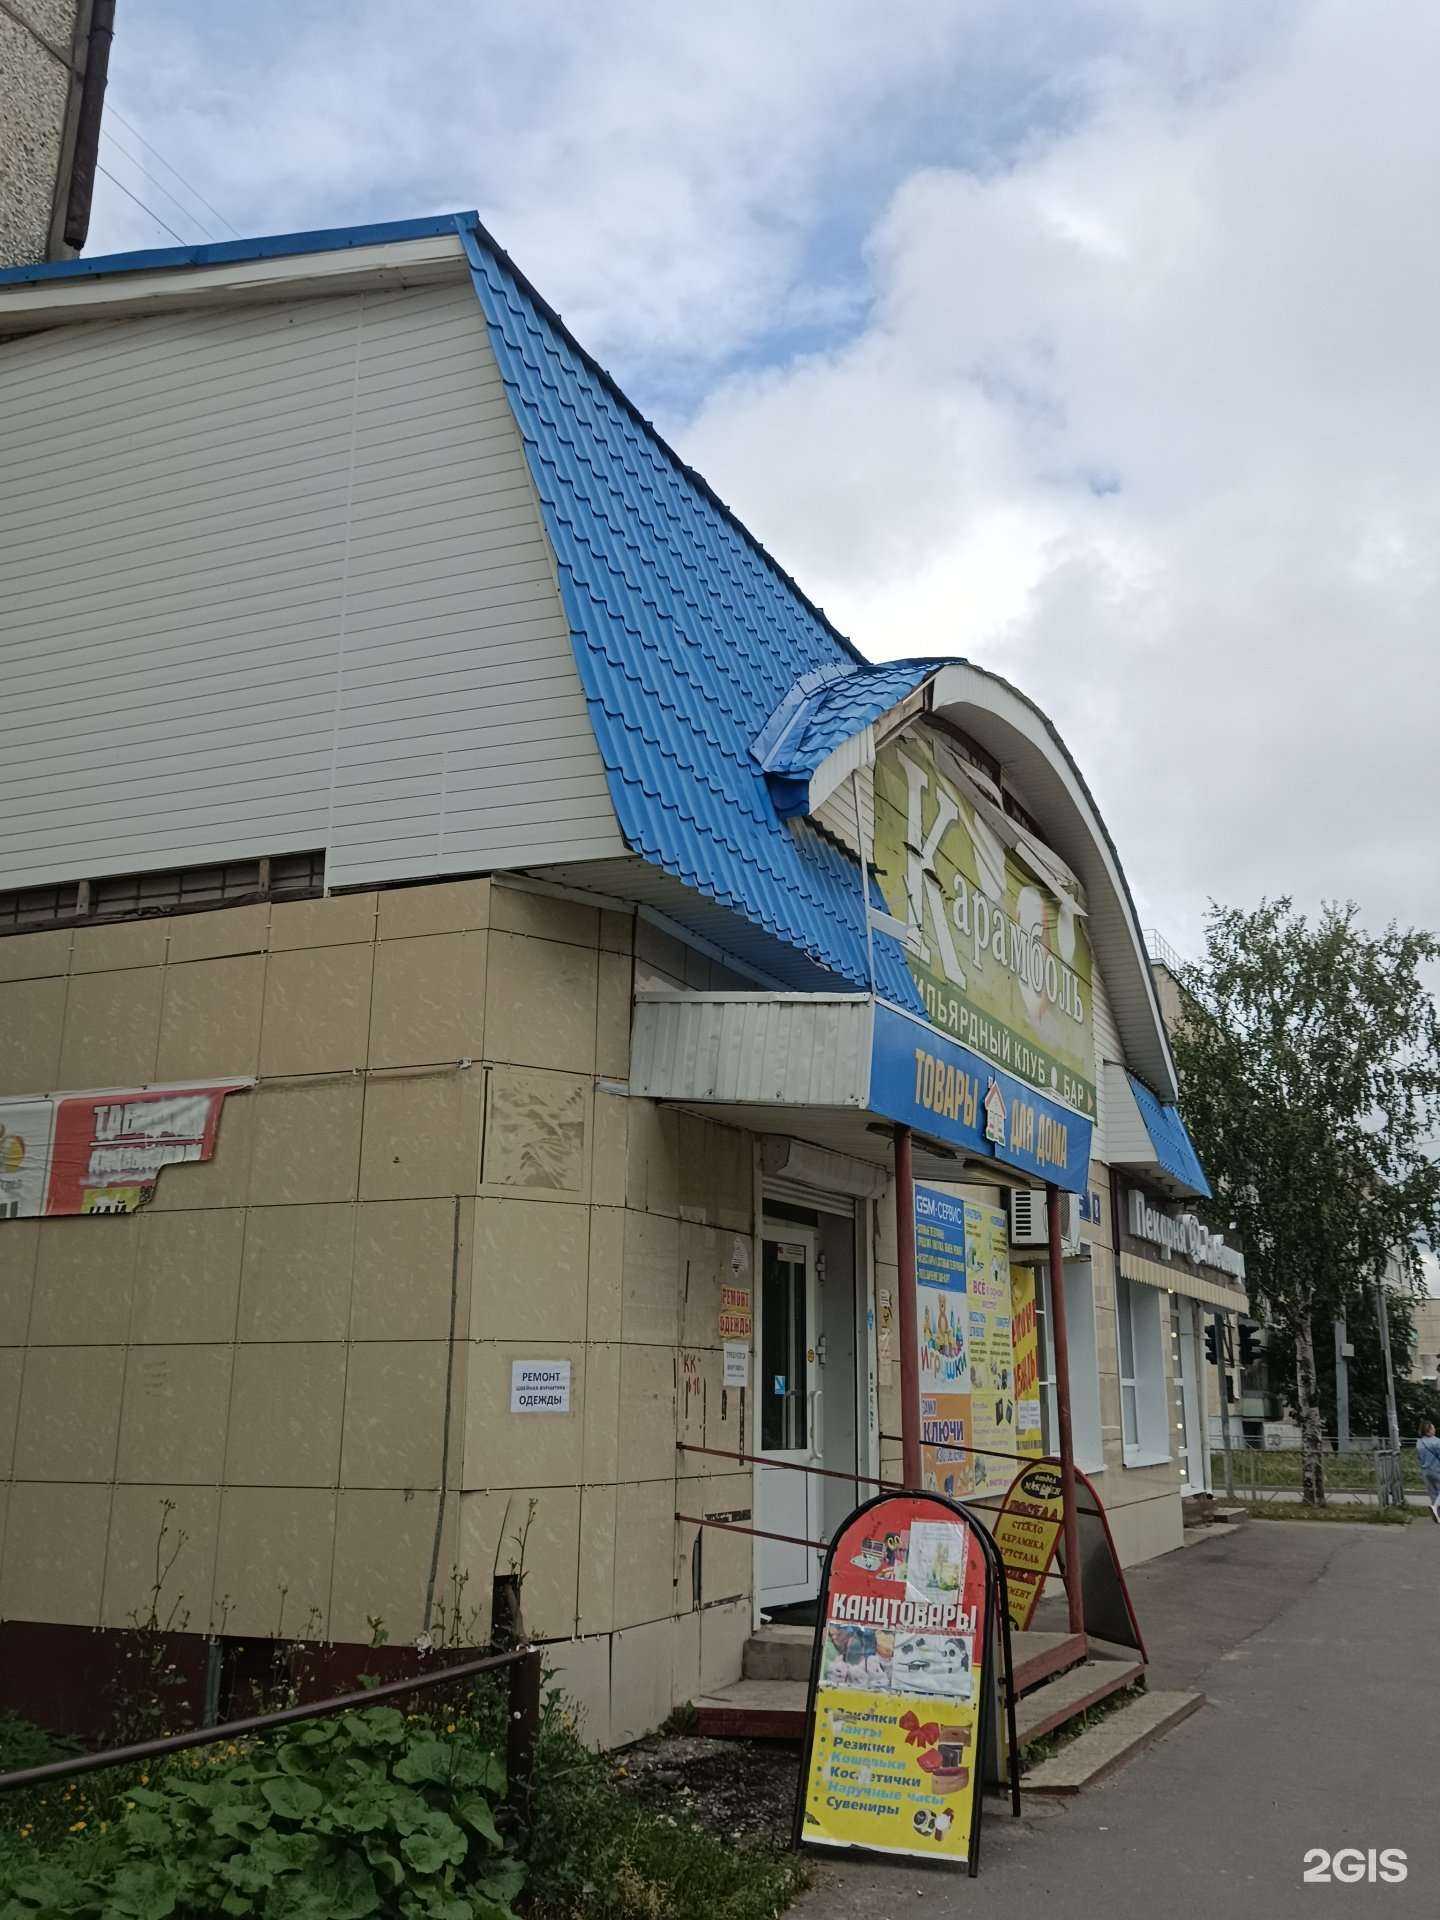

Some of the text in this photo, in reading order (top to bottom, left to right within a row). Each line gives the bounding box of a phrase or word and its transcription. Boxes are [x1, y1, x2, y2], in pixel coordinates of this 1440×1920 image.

[896, 748, 1083, 1024] Карамболь
[913, 973, 1084, 1108] ИЛЬЯРДНЫЙ КЛУБ БАР
[914, 1048, 1068, 1169] ТОВАРЫ ДЛЯ ДОМА
[722, 1288, 750, 1308] РЕМОНТ
[719, 1316, 751, 1336] ОДЕЖДЫ
[920, 1343, 967, 1380] Игршки
[522, 1372, 561, 1382] РЕМОНТ
[519, 1395, 562, 1407] ОДЕЖДЫ
[923, 1420, 965, 1443] КЛЮЧИ
[1011, 1520, 1044, 1535] СТЕКЛО
[1001, 1532, 1045, 1551] КЕРАМИКА
[831, 1592, 977, 1632] КАНЦТОВАРЫ
[839, 1726, 882, 1737] анты
[829, 1766, 922, 1787] Косетички
[825, 1795, 900, 1815] Сувениры
